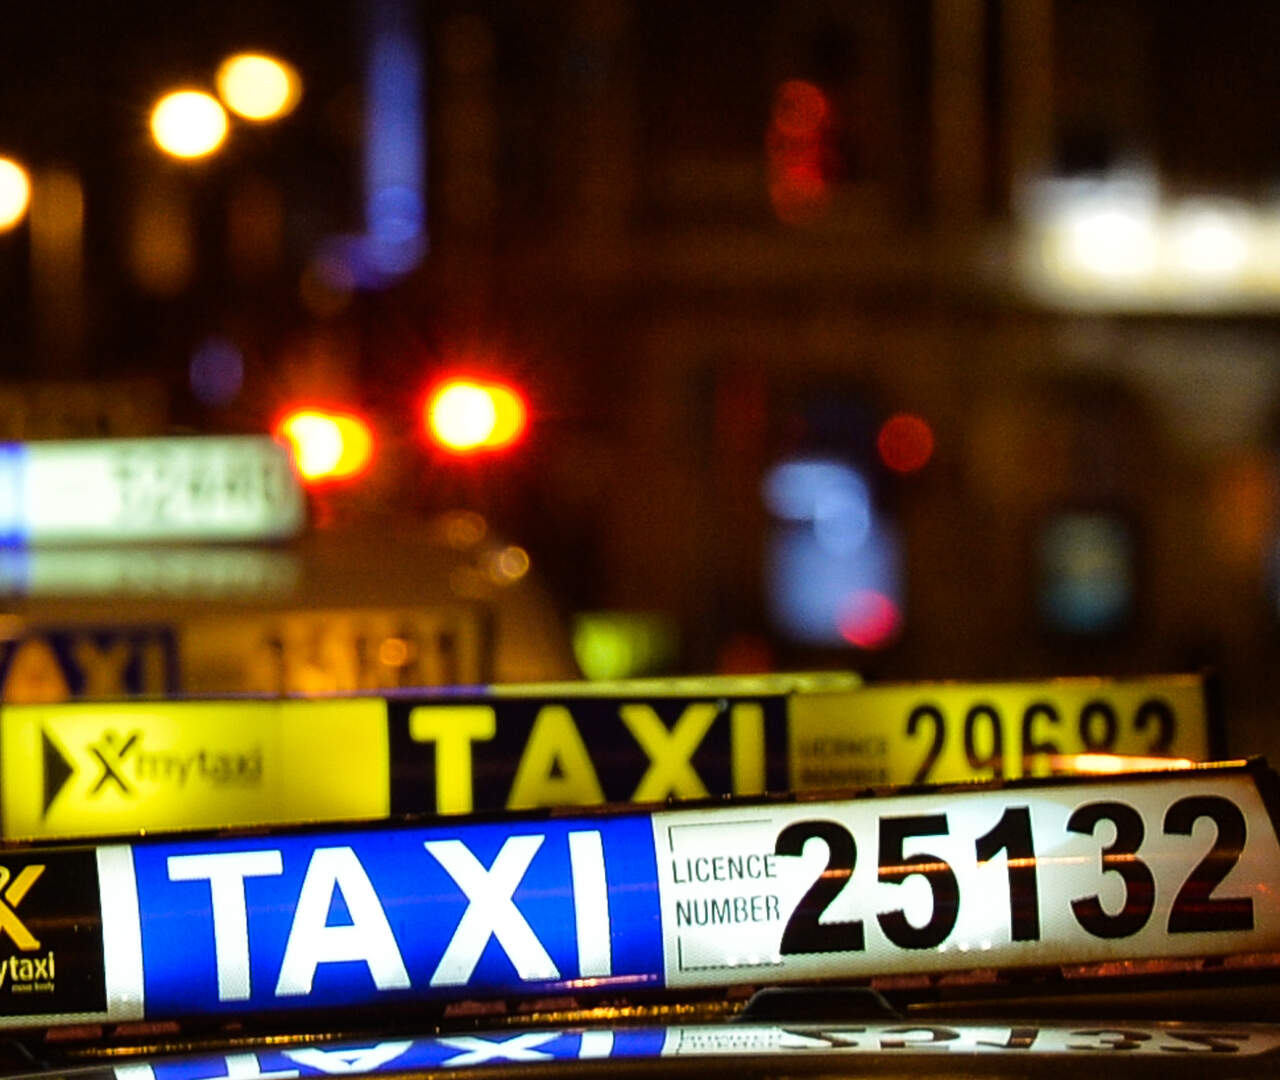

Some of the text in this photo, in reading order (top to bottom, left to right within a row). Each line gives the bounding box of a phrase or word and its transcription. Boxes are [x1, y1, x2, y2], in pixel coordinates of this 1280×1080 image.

[409, 703, 766, 816] TAXI
[167, 829, 612, 1001] TAXI
[673, 854, 778, 885] LICENCE
[676, 895, 780, 927] NUMBER
[773, 795, 1255, 956] 25132
